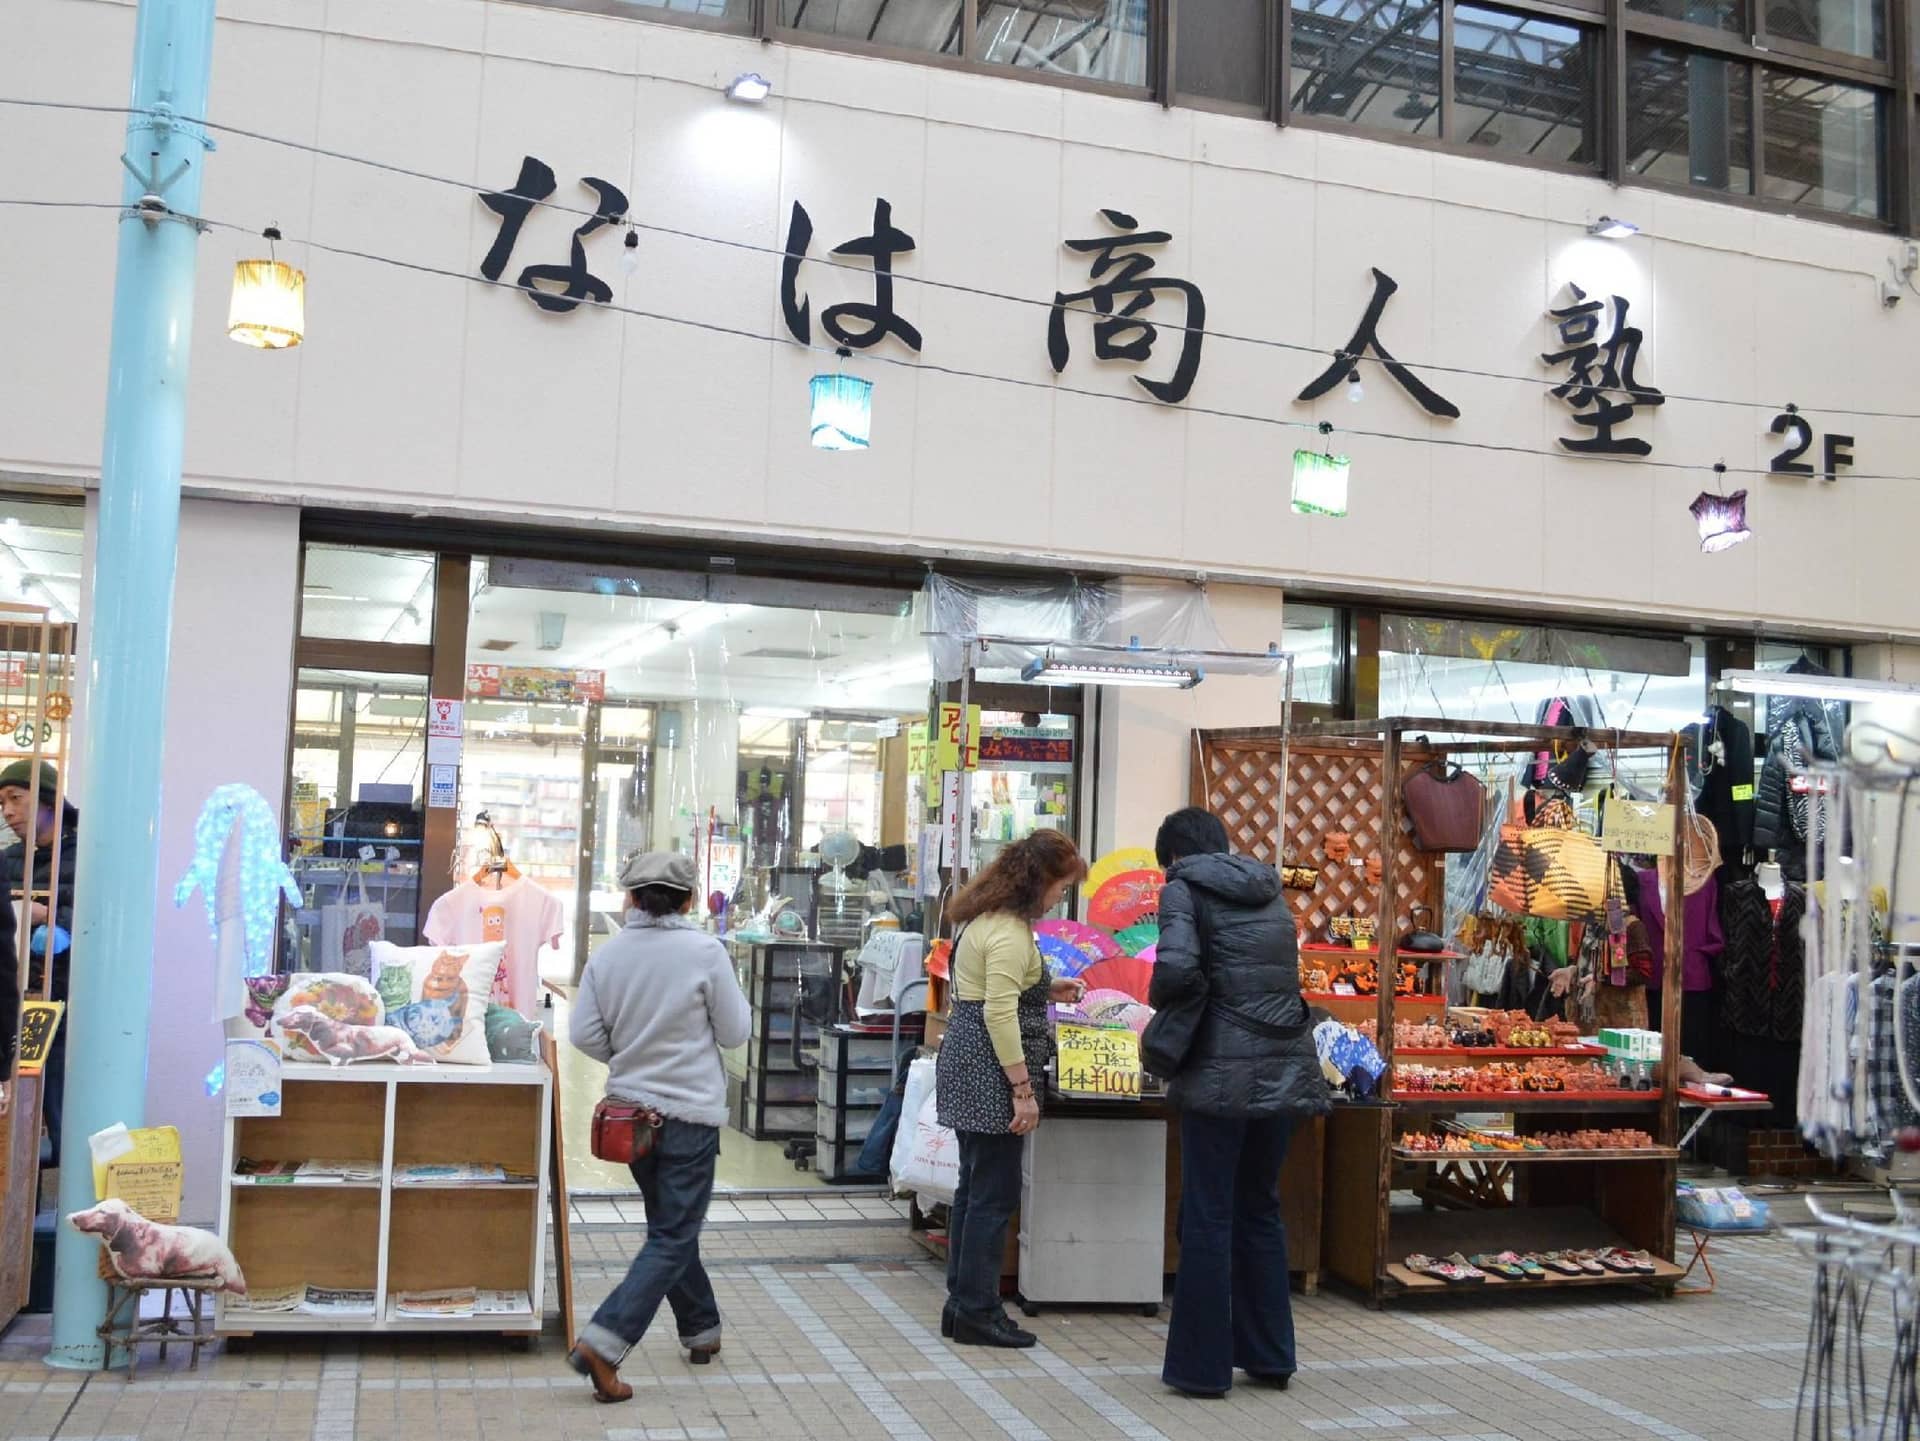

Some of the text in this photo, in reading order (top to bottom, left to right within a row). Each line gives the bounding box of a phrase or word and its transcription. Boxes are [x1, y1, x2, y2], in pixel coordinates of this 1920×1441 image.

[477, 155, 1666, 457] なは商人塾
[1769, 413, 1855, 482] 2F
[1061, 1028, 1127, 1052] 落ちない
[1094, 1053, 1132, 1067] 口紅
